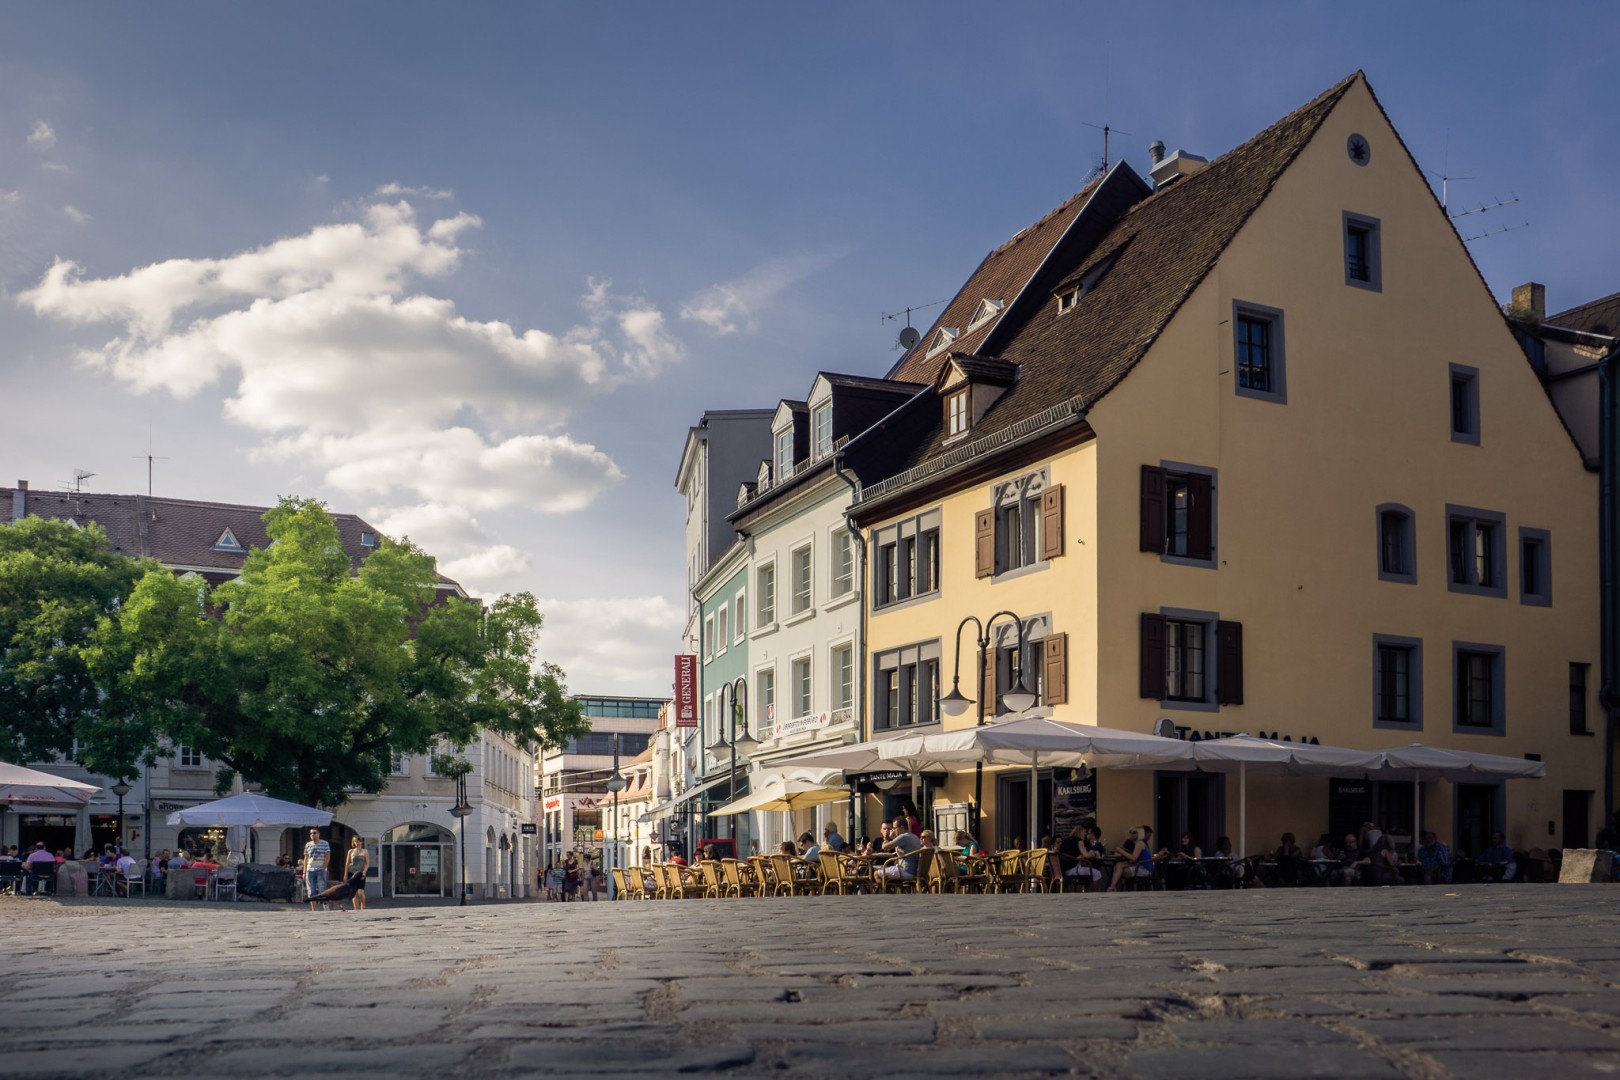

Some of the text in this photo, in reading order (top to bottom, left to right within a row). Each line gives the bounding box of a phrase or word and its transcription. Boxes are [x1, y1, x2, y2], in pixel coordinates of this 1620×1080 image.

[681, 656, 692, 704] GENERALI
[1175, 726, 1249, 742] TANT
[1057, 784, 1092, 796] KARLSBERG
[158, 802, 184, 810] shoes
